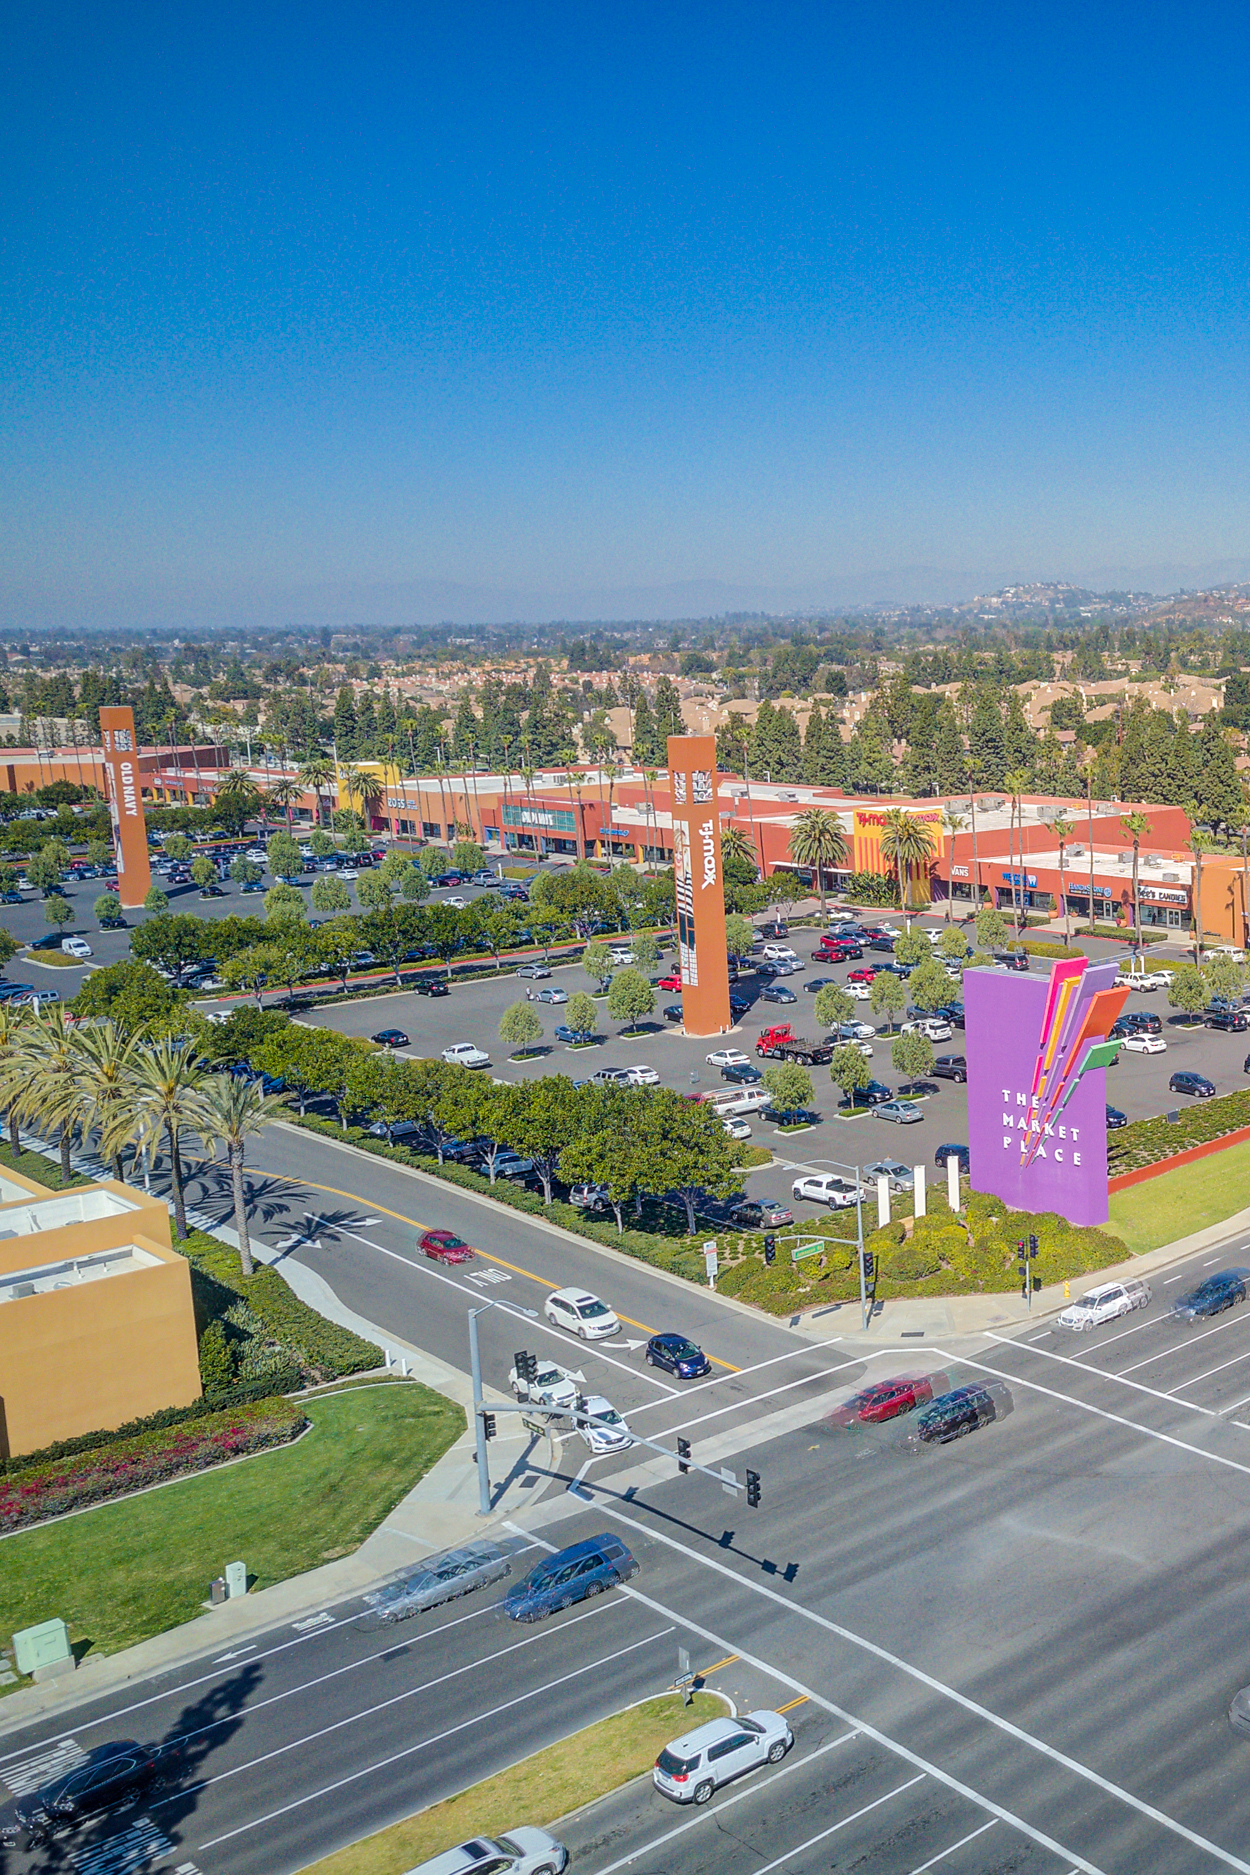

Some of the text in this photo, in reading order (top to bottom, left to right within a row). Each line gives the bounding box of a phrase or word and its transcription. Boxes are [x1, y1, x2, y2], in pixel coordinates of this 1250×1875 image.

[120, 762, 138, 817] OLD NAVY
[951, 866, 969, 878] VANS
[1158, 892, 1186, 902] CANDIES
[1002, 1089, 1039, 1109] THE
[1003, 1112, 1080, 1142] MARKET
[1003, 1136, 1081, 1167] PLACE
[463, 1268, 512, 1287] ONLY
